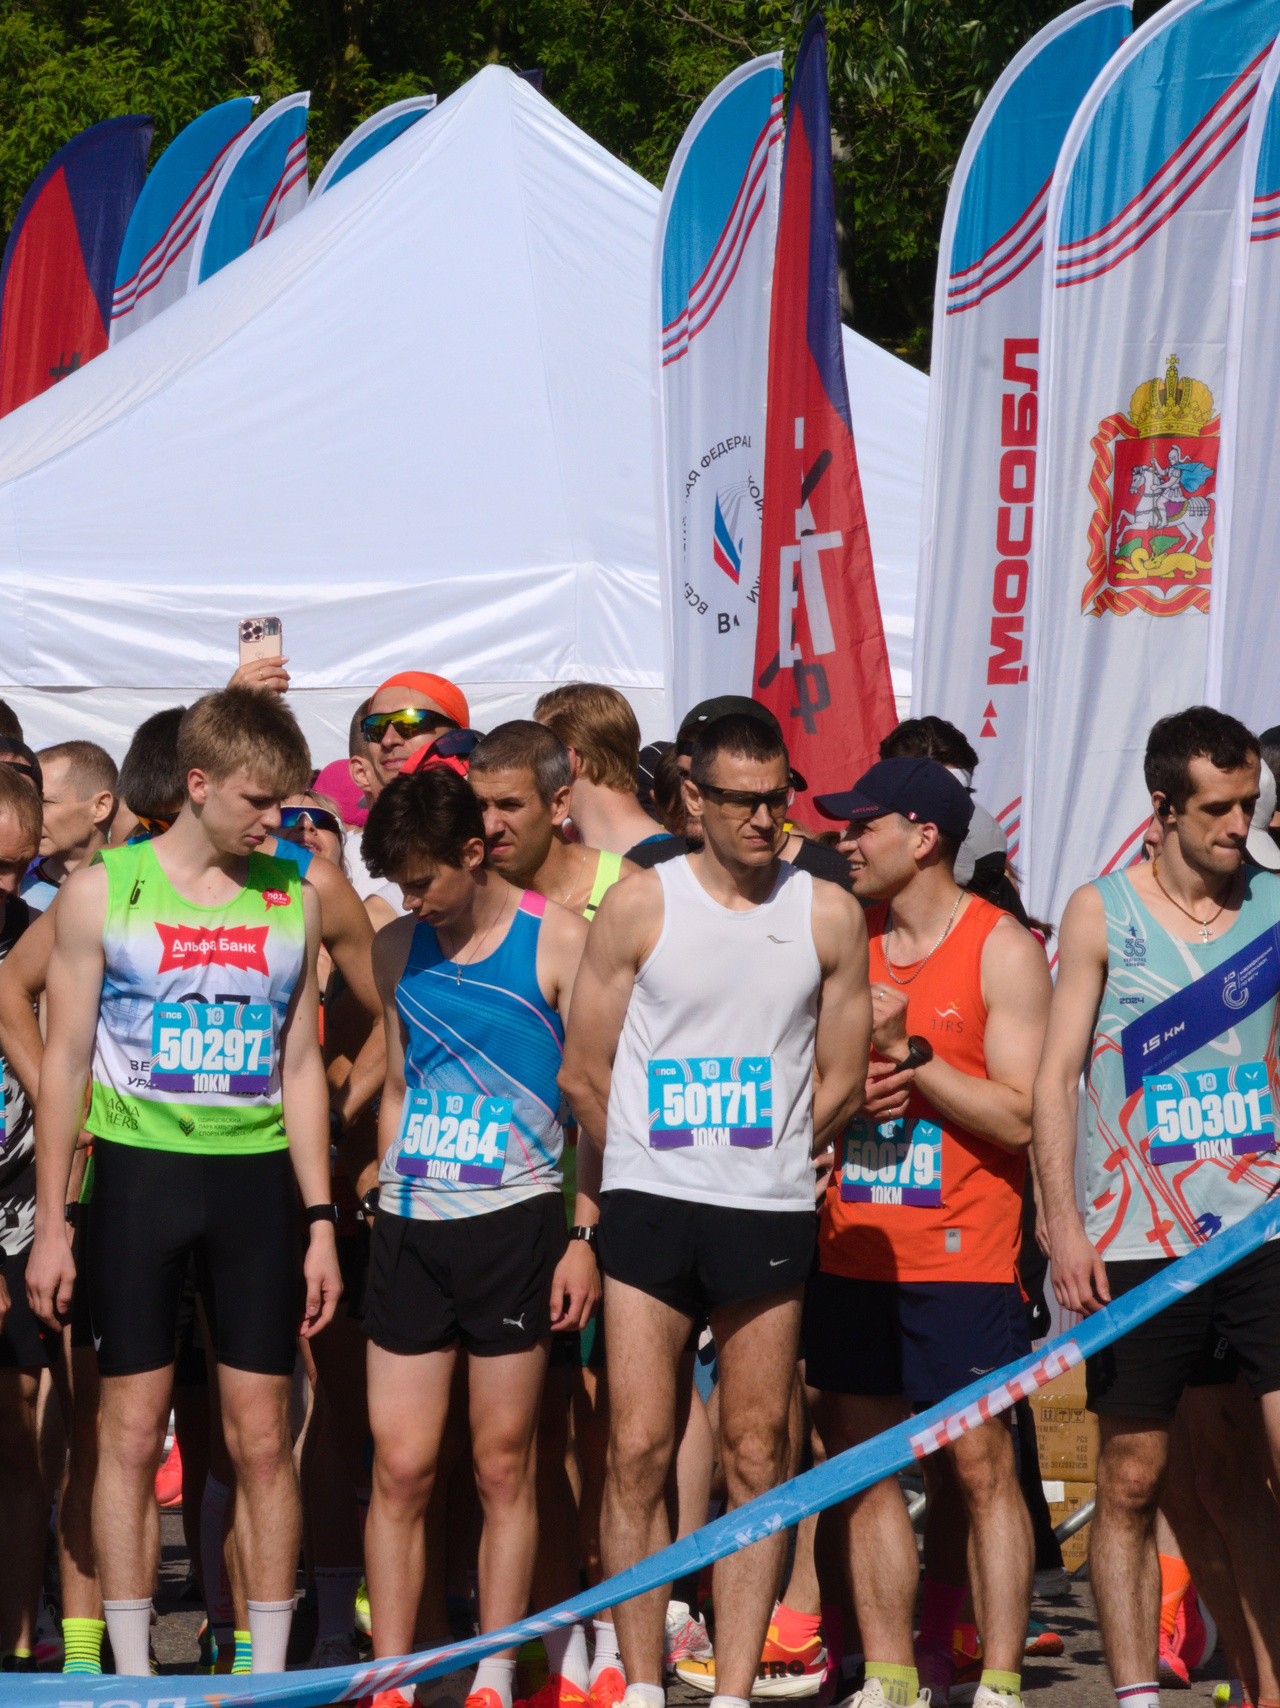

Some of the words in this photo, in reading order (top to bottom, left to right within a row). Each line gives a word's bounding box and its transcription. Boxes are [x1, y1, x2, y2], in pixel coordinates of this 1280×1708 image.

[852, 805, 879, 814] ARTENGO
[172, 938, 216, 957] Альфа
[219, 938, 257, 954] Банк
[1123, 938, 1147, 957] 35
[930, 1019, 964, 1033] TIRS
[159, 1027, 263, 1071] 50297
[1142, 1035, 1160, 1056] 15
[106, 1097, 140, 1118] AQUA
[663, 1081, 756, 1126] 50171
[105, 1111, 139, 1130] HERB
[1156, 1088, 1262, 1143] 50301
[403, 1113, 499, 1164] 50264
[847, 1139, 934, 1185] 50079
